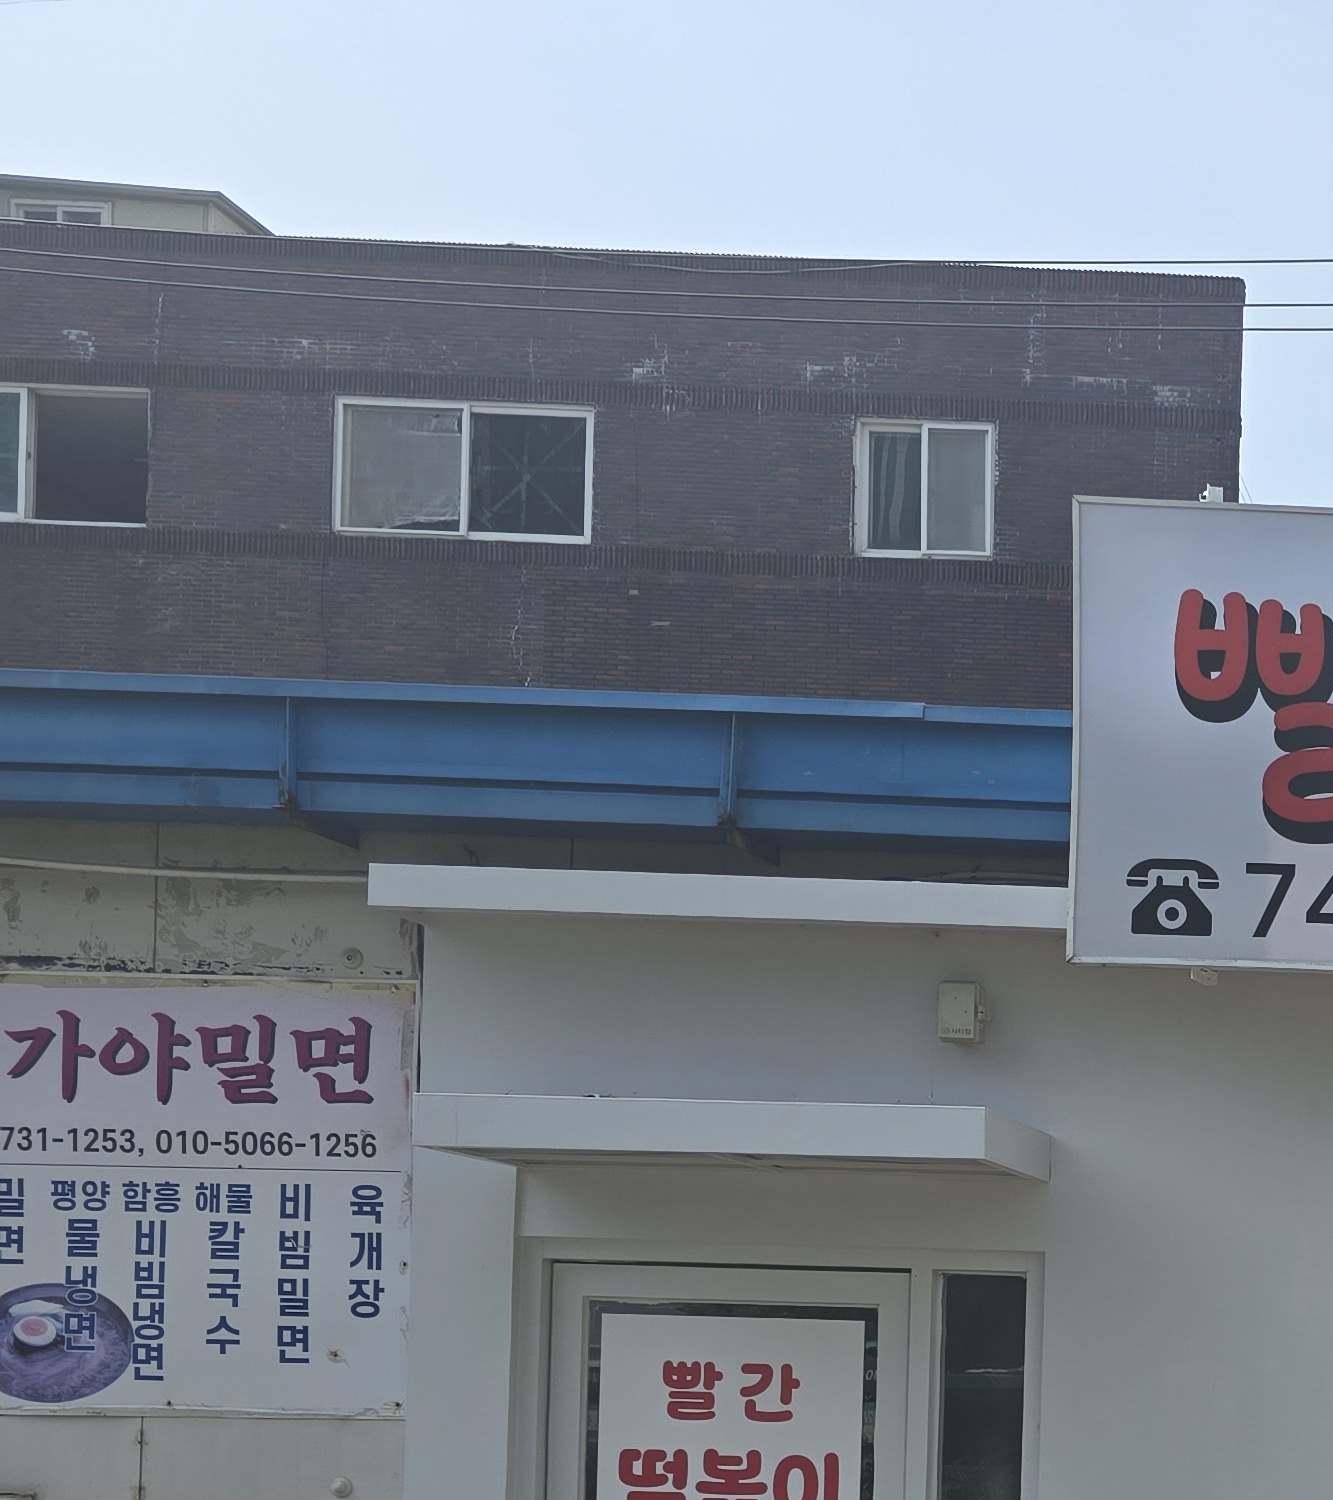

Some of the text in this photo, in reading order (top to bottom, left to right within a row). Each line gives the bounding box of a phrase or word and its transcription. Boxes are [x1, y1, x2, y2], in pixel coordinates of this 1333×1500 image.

[4, 1010, 375, 1105] 가야밀면
[155, 1128, 378, 1158] 010-5066-1256
[50, 1180, 111, 1353] 평양 물냉면
[121, 1181, 182, 1382] 함흥 비빔냉면
[194, 1182, 254, 1355] 해물 칼국수
[276, 1183, 313, 1365] 비빔밀면
[347, 1184, 386, 1319] 육개장
[662, 1360, 801, 1422] 빨간
